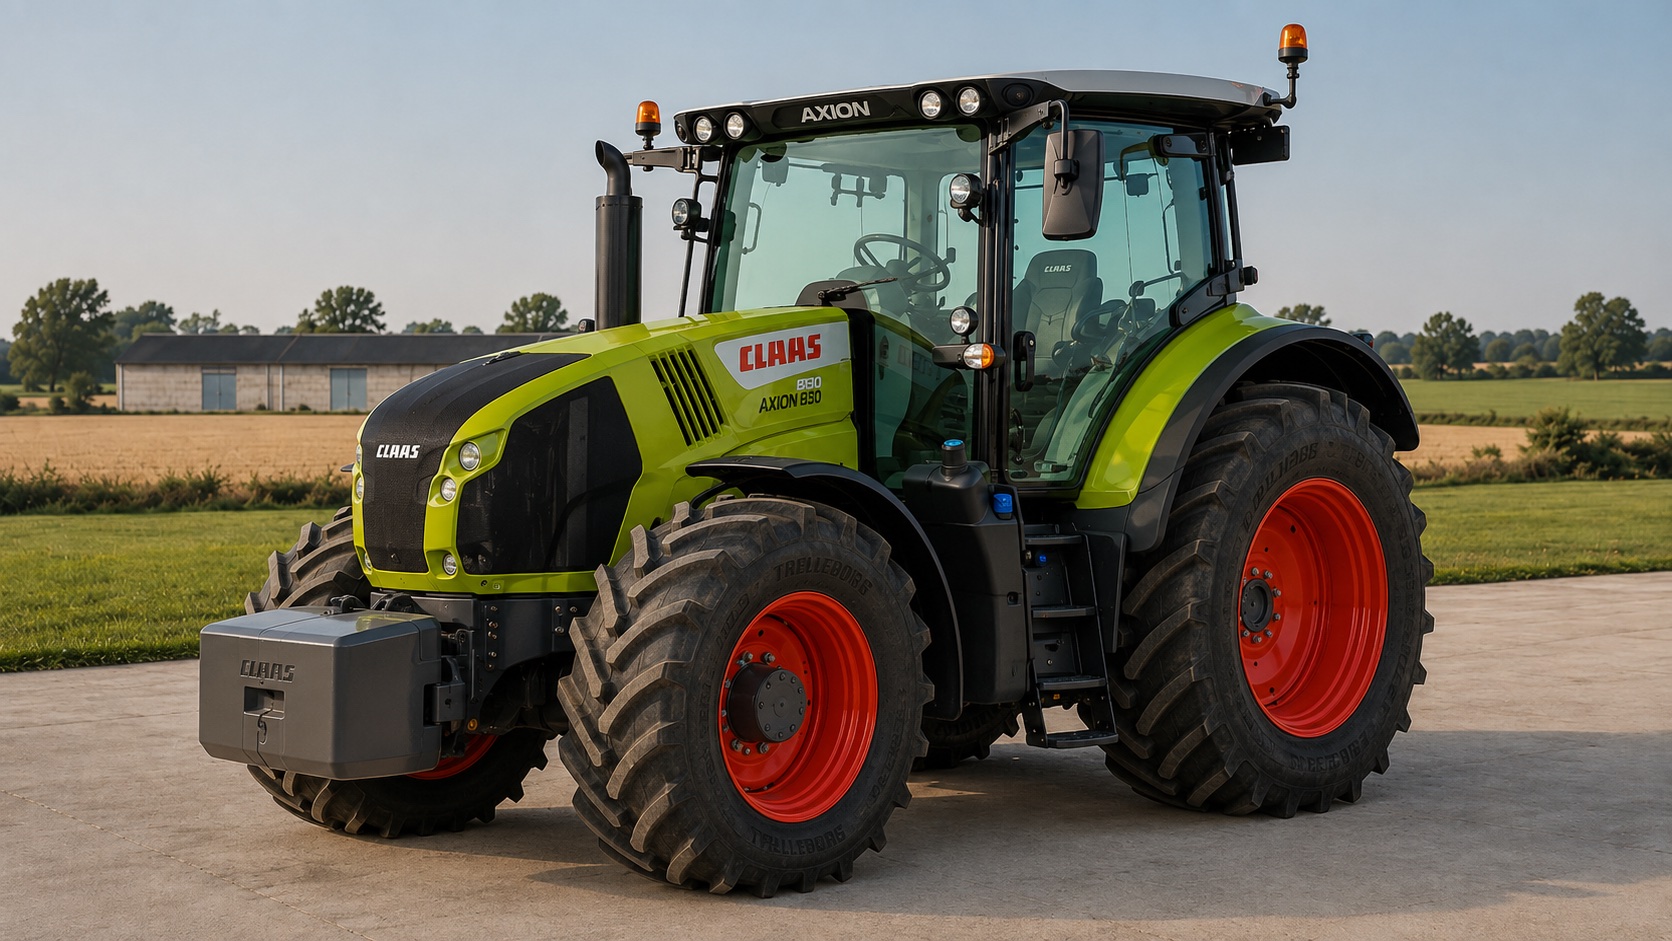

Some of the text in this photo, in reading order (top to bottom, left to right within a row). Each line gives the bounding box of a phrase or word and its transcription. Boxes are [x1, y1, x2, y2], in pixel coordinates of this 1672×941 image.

[801, 100, 871, 123] AXION
[1044, 264, 1072, 273] CLAAS
[739, 333, 822, 373] CLAAS
[759, 393, 798, 413] AXION
[376, 444, 421, 459] CLAAS
[773, 556, 873, 596] TRELLEBORG
[240, 659, 296, 682] CLAAS
